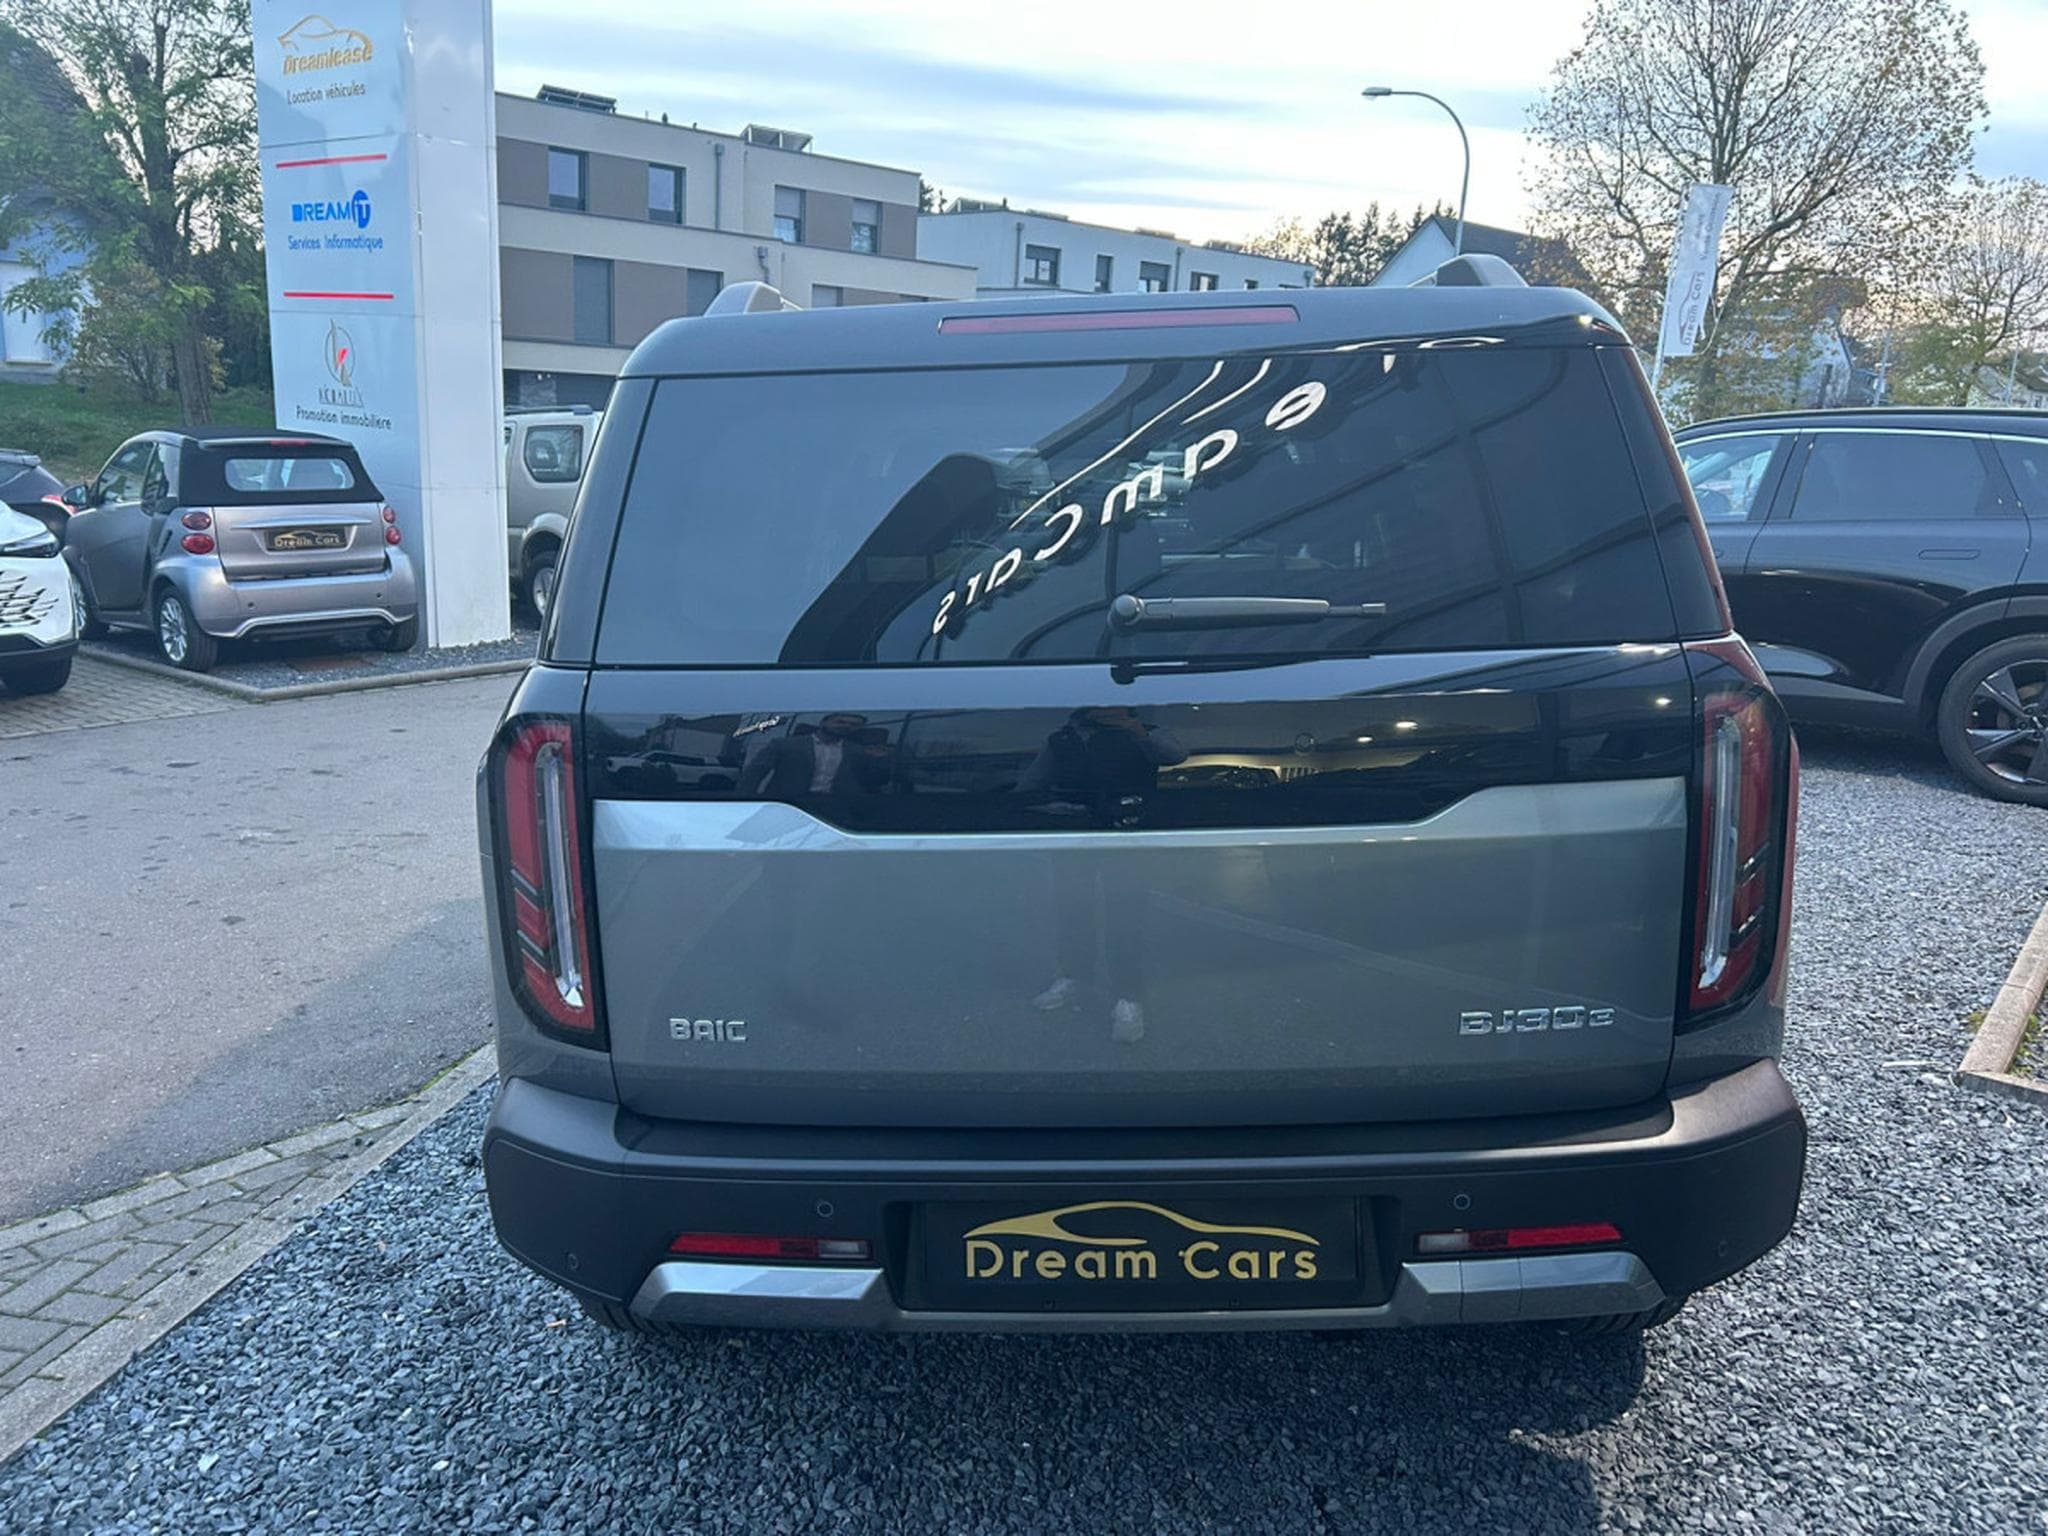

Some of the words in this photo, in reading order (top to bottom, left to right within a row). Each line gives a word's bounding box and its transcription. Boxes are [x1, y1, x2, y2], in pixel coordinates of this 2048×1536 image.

[283, 44, 374, 75] Dreamlease
[287, 86, 323, 105] Location
[325, 80, 367, 99] véhicules
[287, 234, 321, 250] Services
[324, 234, 384, 253] Informatique
[296, 405, 339, 424] Promotion
[668, 1017, 748, 1042] BAIC
[965, 1240, 1157, 1279] Dream
[1178, 1240, 1320, 1280] Cars
